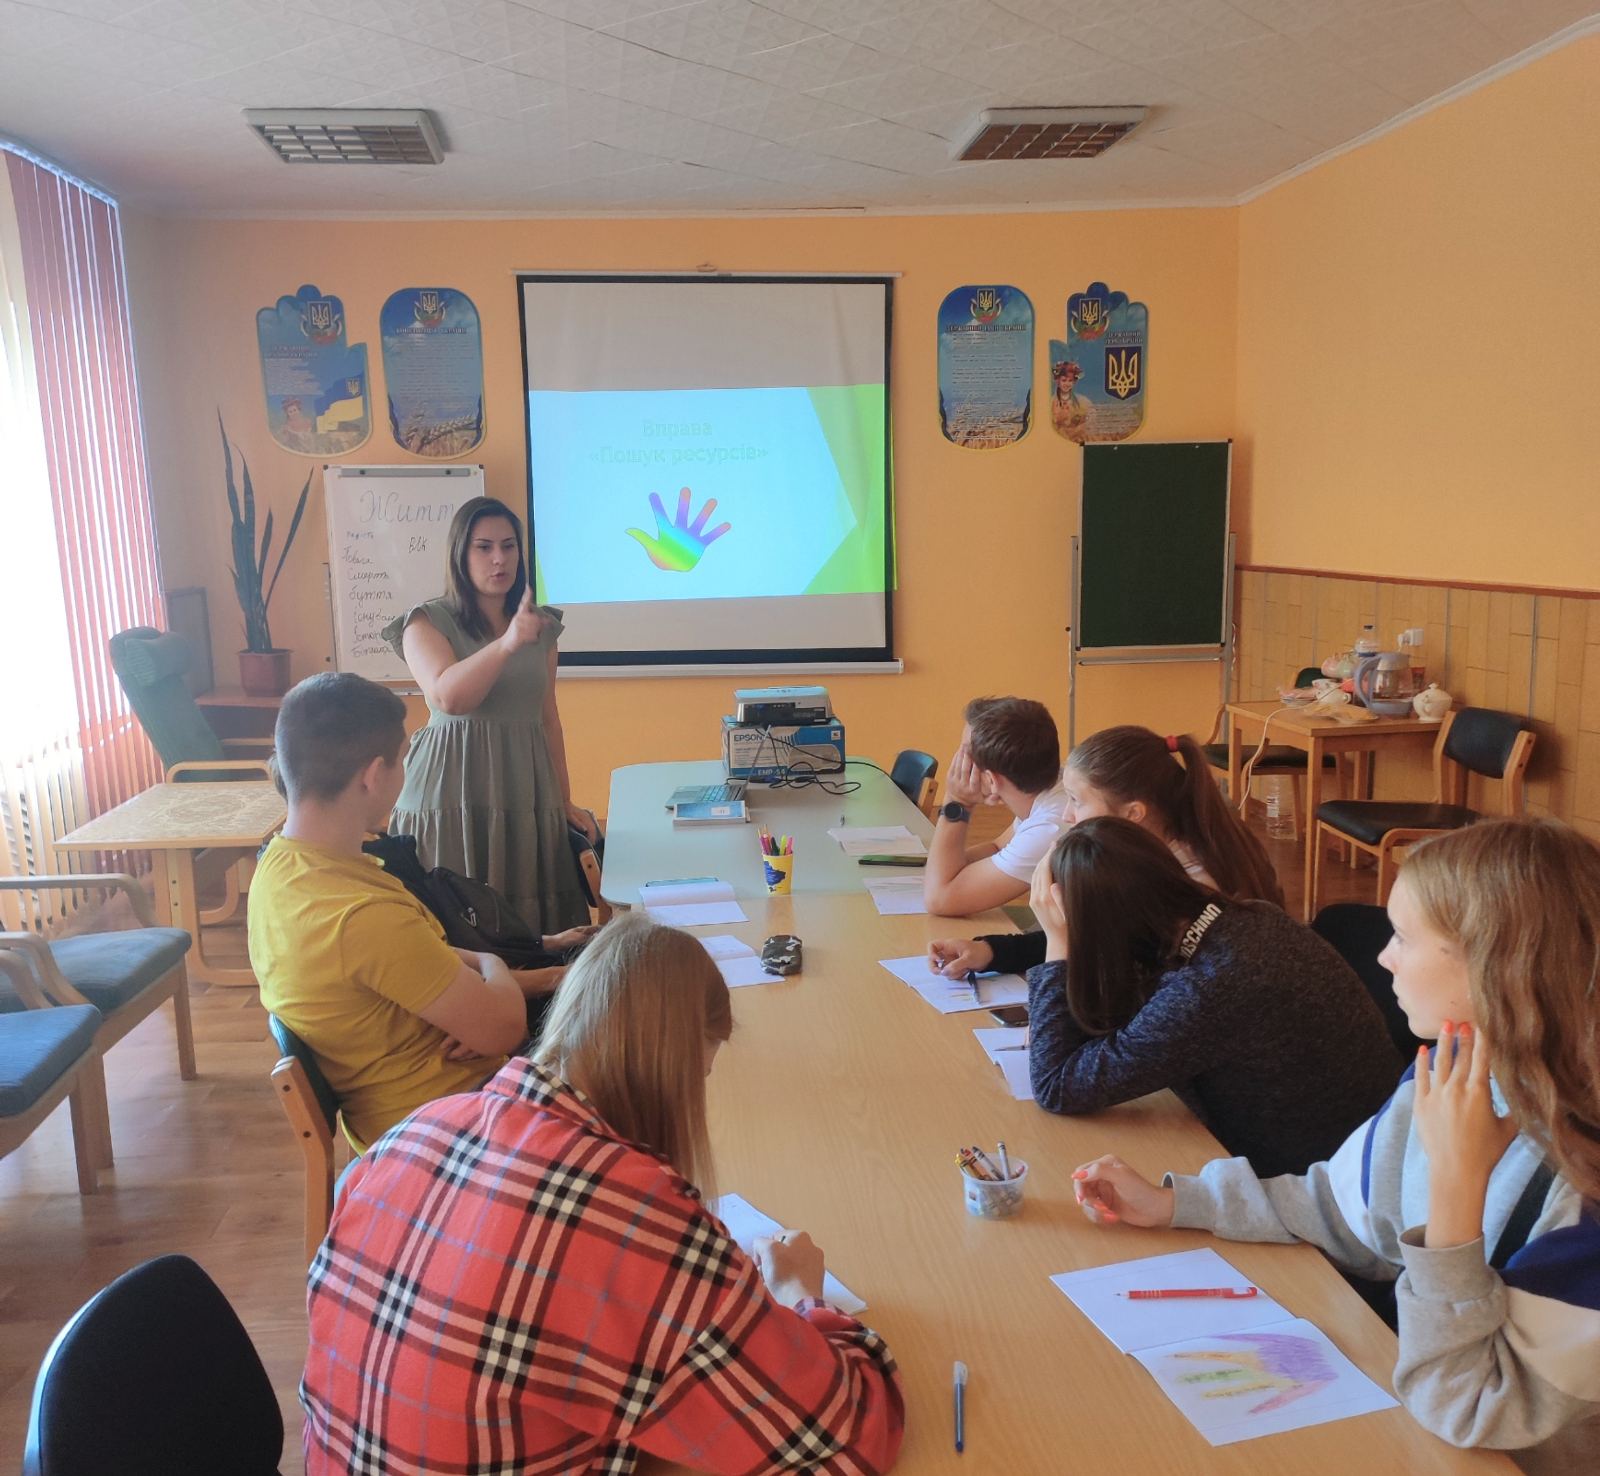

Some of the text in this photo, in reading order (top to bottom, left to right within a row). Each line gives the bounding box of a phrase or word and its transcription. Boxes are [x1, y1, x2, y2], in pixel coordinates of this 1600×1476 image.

[642, 420, 713, 440] Вправа
[359, 489, 455, 523] Житт
[734, 734, 763, 742] EPSON
[1179, 903, 1223, 959] OSCHINO
